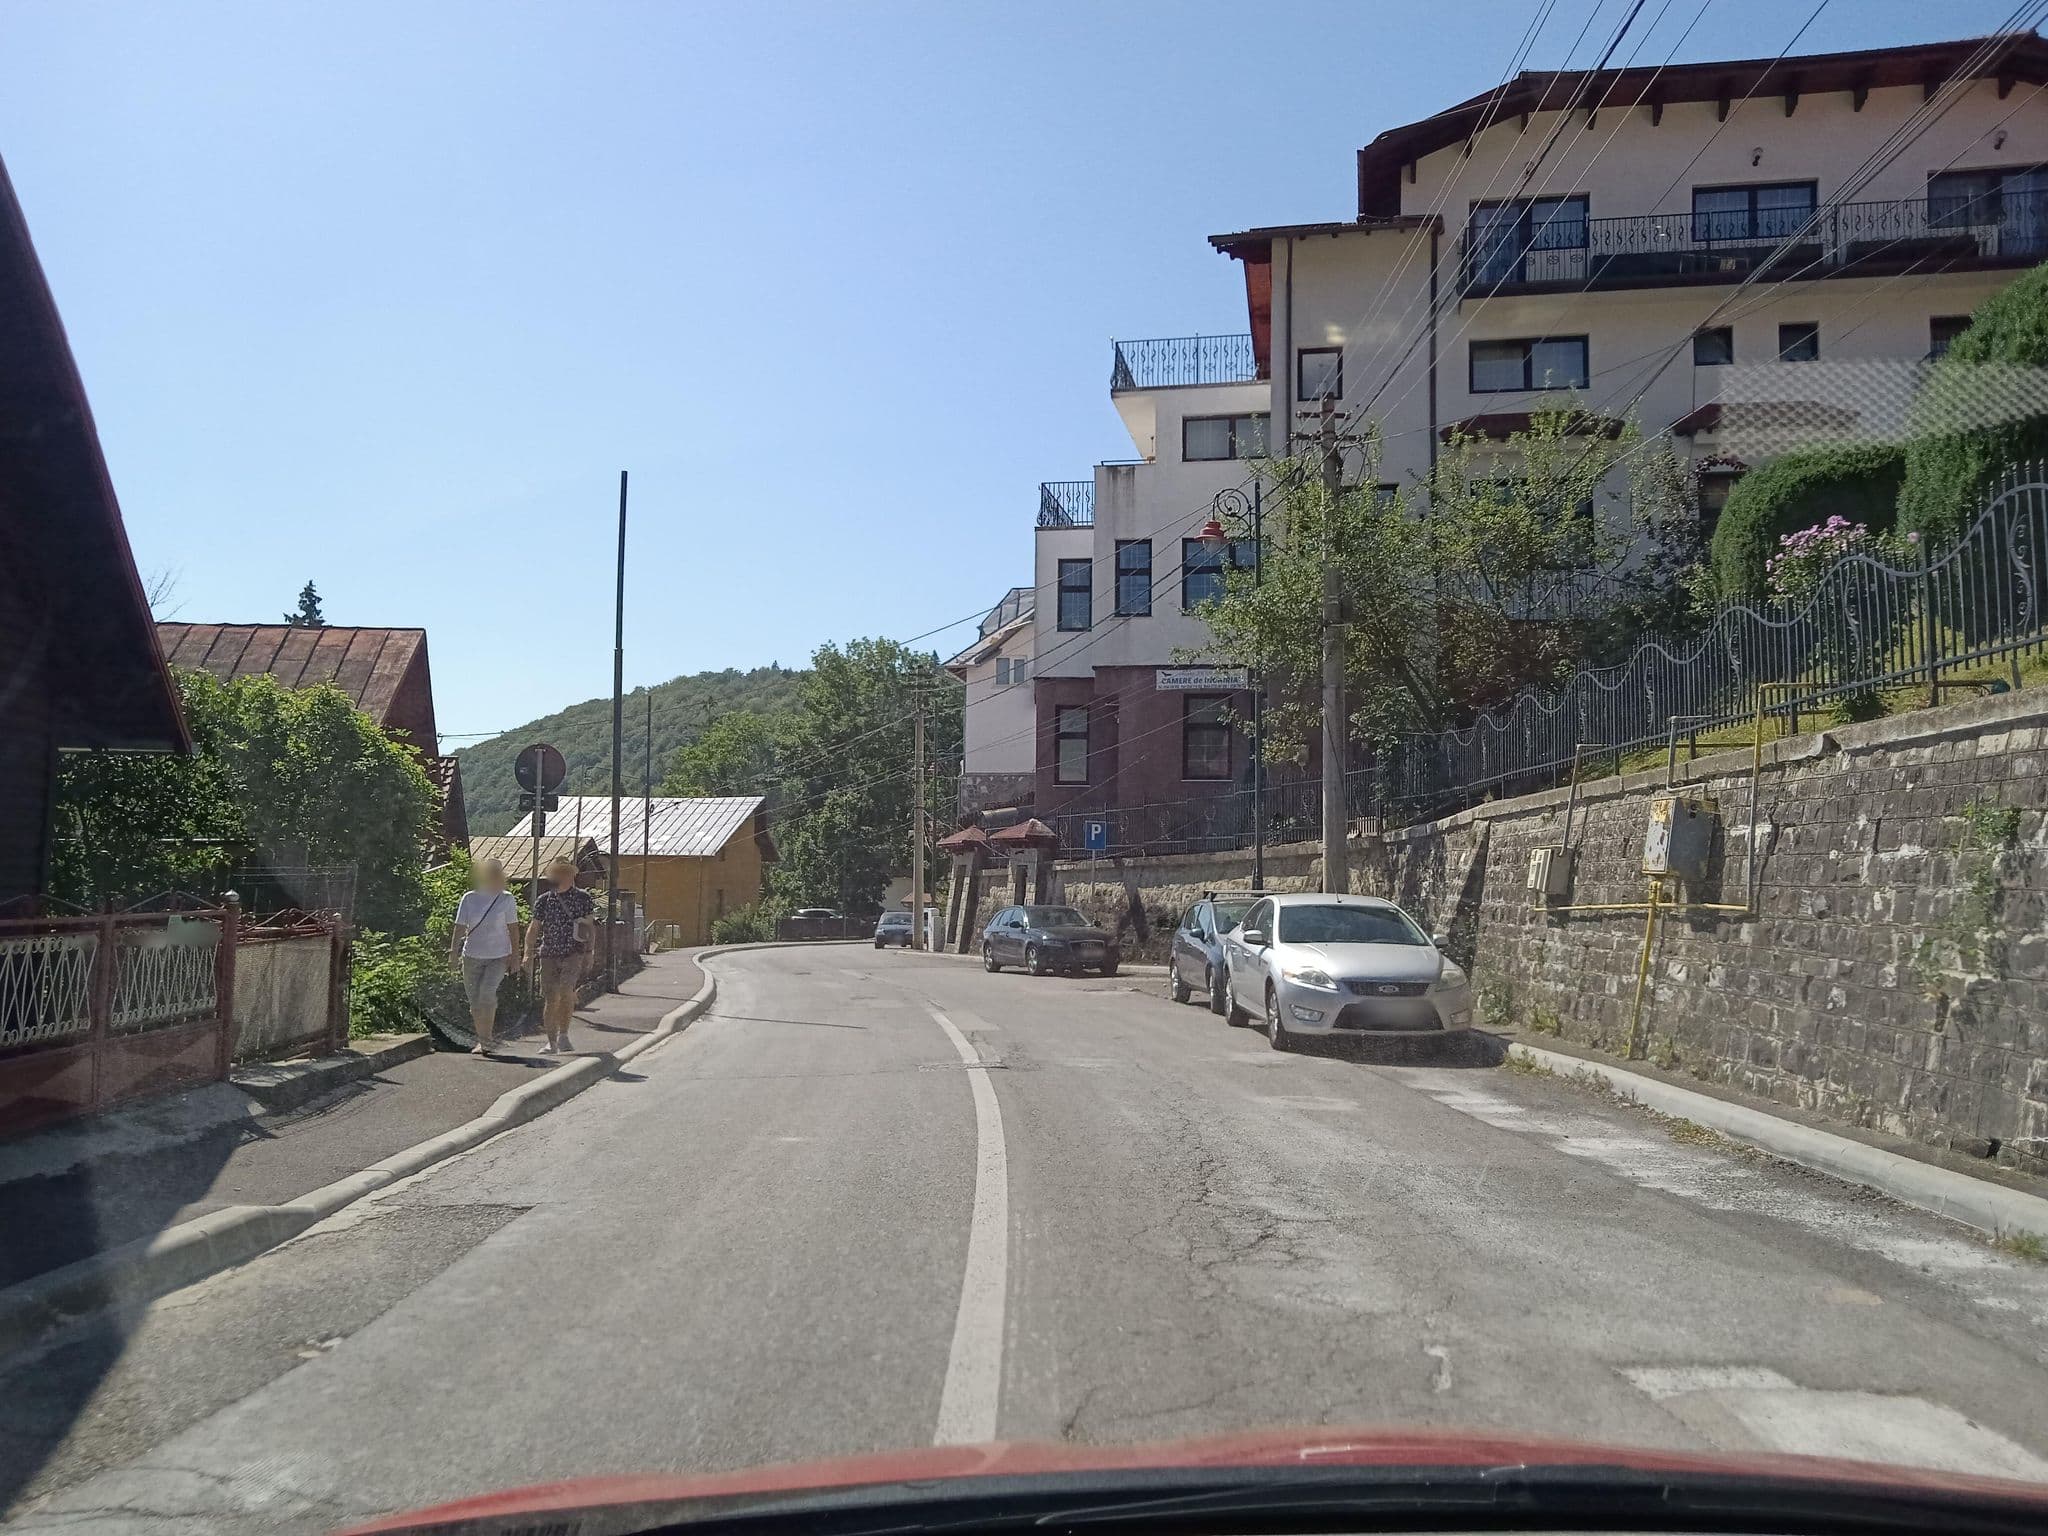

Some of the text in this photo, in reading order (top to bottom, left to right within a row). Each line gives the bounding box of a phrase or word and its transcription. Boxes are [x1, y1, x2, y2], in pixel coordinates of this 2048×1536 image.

[1161, 677, 1192, 685] CAMERE
[1193, 676, 1203, 684] de
[1091, 824, 1101, 840] P
